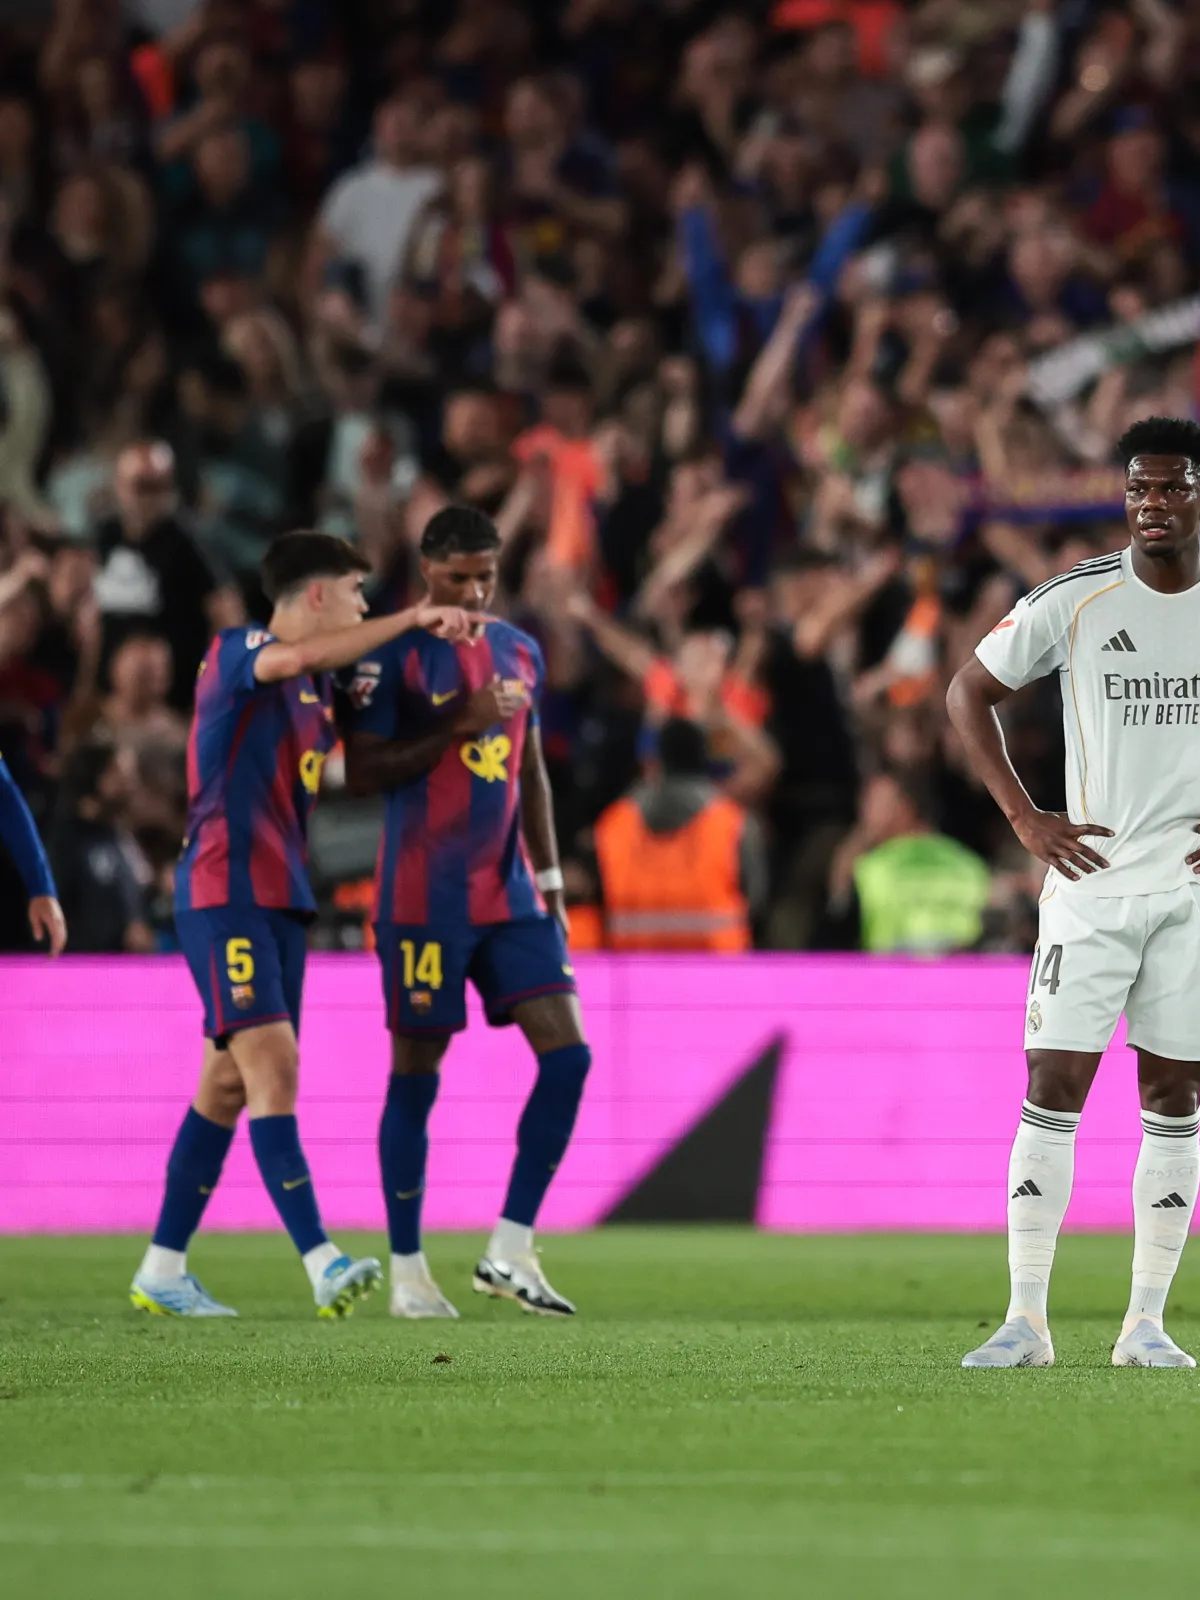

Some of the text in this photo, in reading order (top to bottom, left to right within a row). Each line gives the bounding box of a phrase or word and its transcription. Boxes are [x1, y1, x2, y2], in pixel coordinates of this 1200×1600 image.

[1123, 704, 1150, 726] FLY
[226, 938, 254, 983] 5
[400, 939, 443, 989] 14
